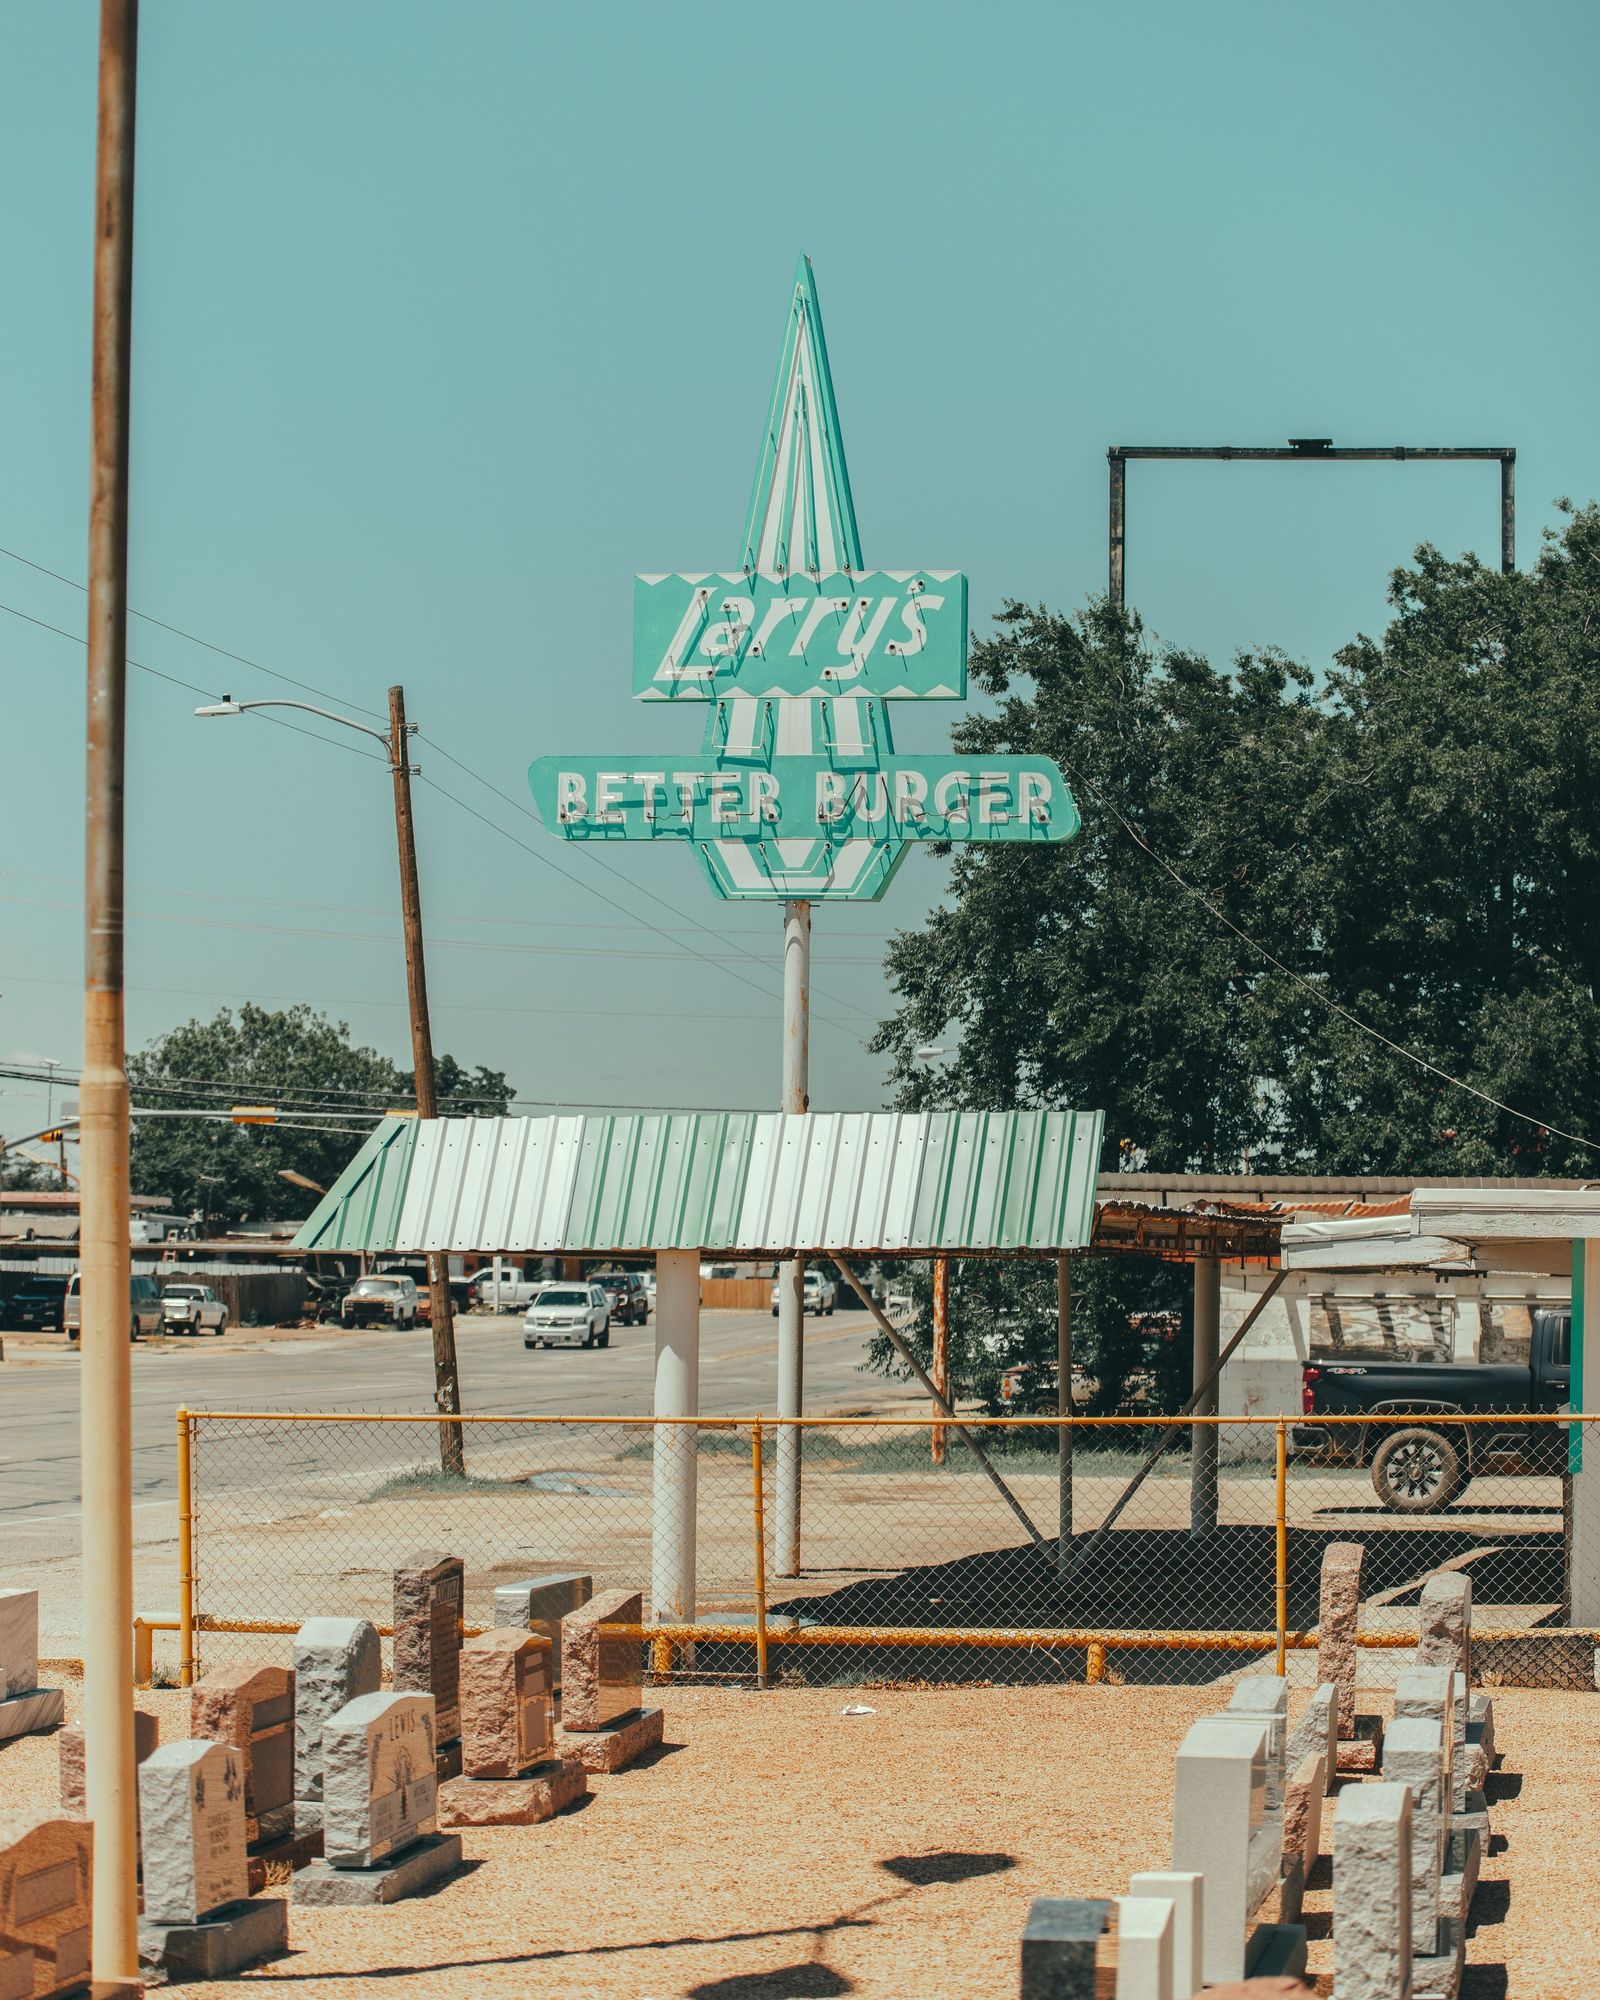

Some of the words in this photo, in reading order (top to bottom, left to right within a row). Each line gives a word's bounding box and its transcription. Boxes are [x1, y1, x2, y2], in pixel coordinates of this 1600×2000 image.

[653, 579, 945, 681] Larry's
[556, 771, 782, 825] BETTER
[816, 770, 1052, 825] BURGER
[436, 1578, 459, 1604] CORTEZ
[389, 1709, 416, 1742] LEWIS
